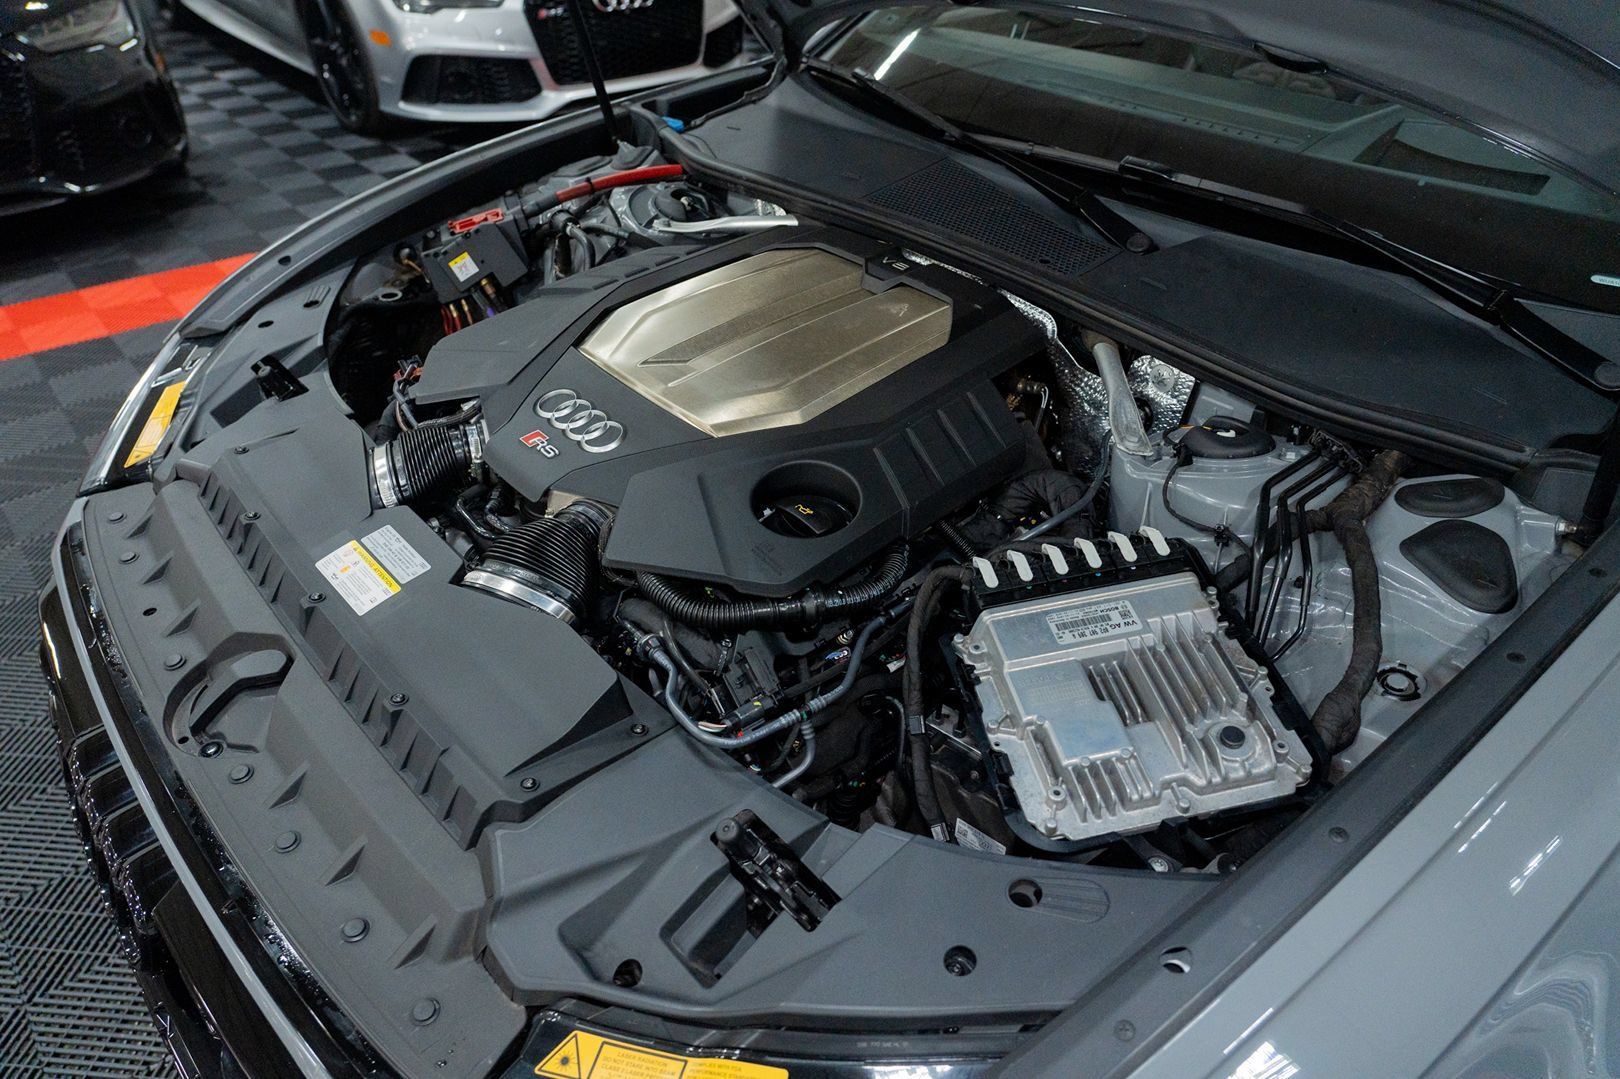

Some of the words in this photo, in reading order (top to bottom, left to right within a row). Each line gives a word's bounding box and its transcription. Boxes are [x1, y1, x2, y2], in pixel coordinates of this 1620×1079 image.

[882, 256, 910, 271] V8
[525, 434, 560, 458] RS
[1100, 606, 1119, 614] BOSCH
[1123, 619, 1138, 627] VW
